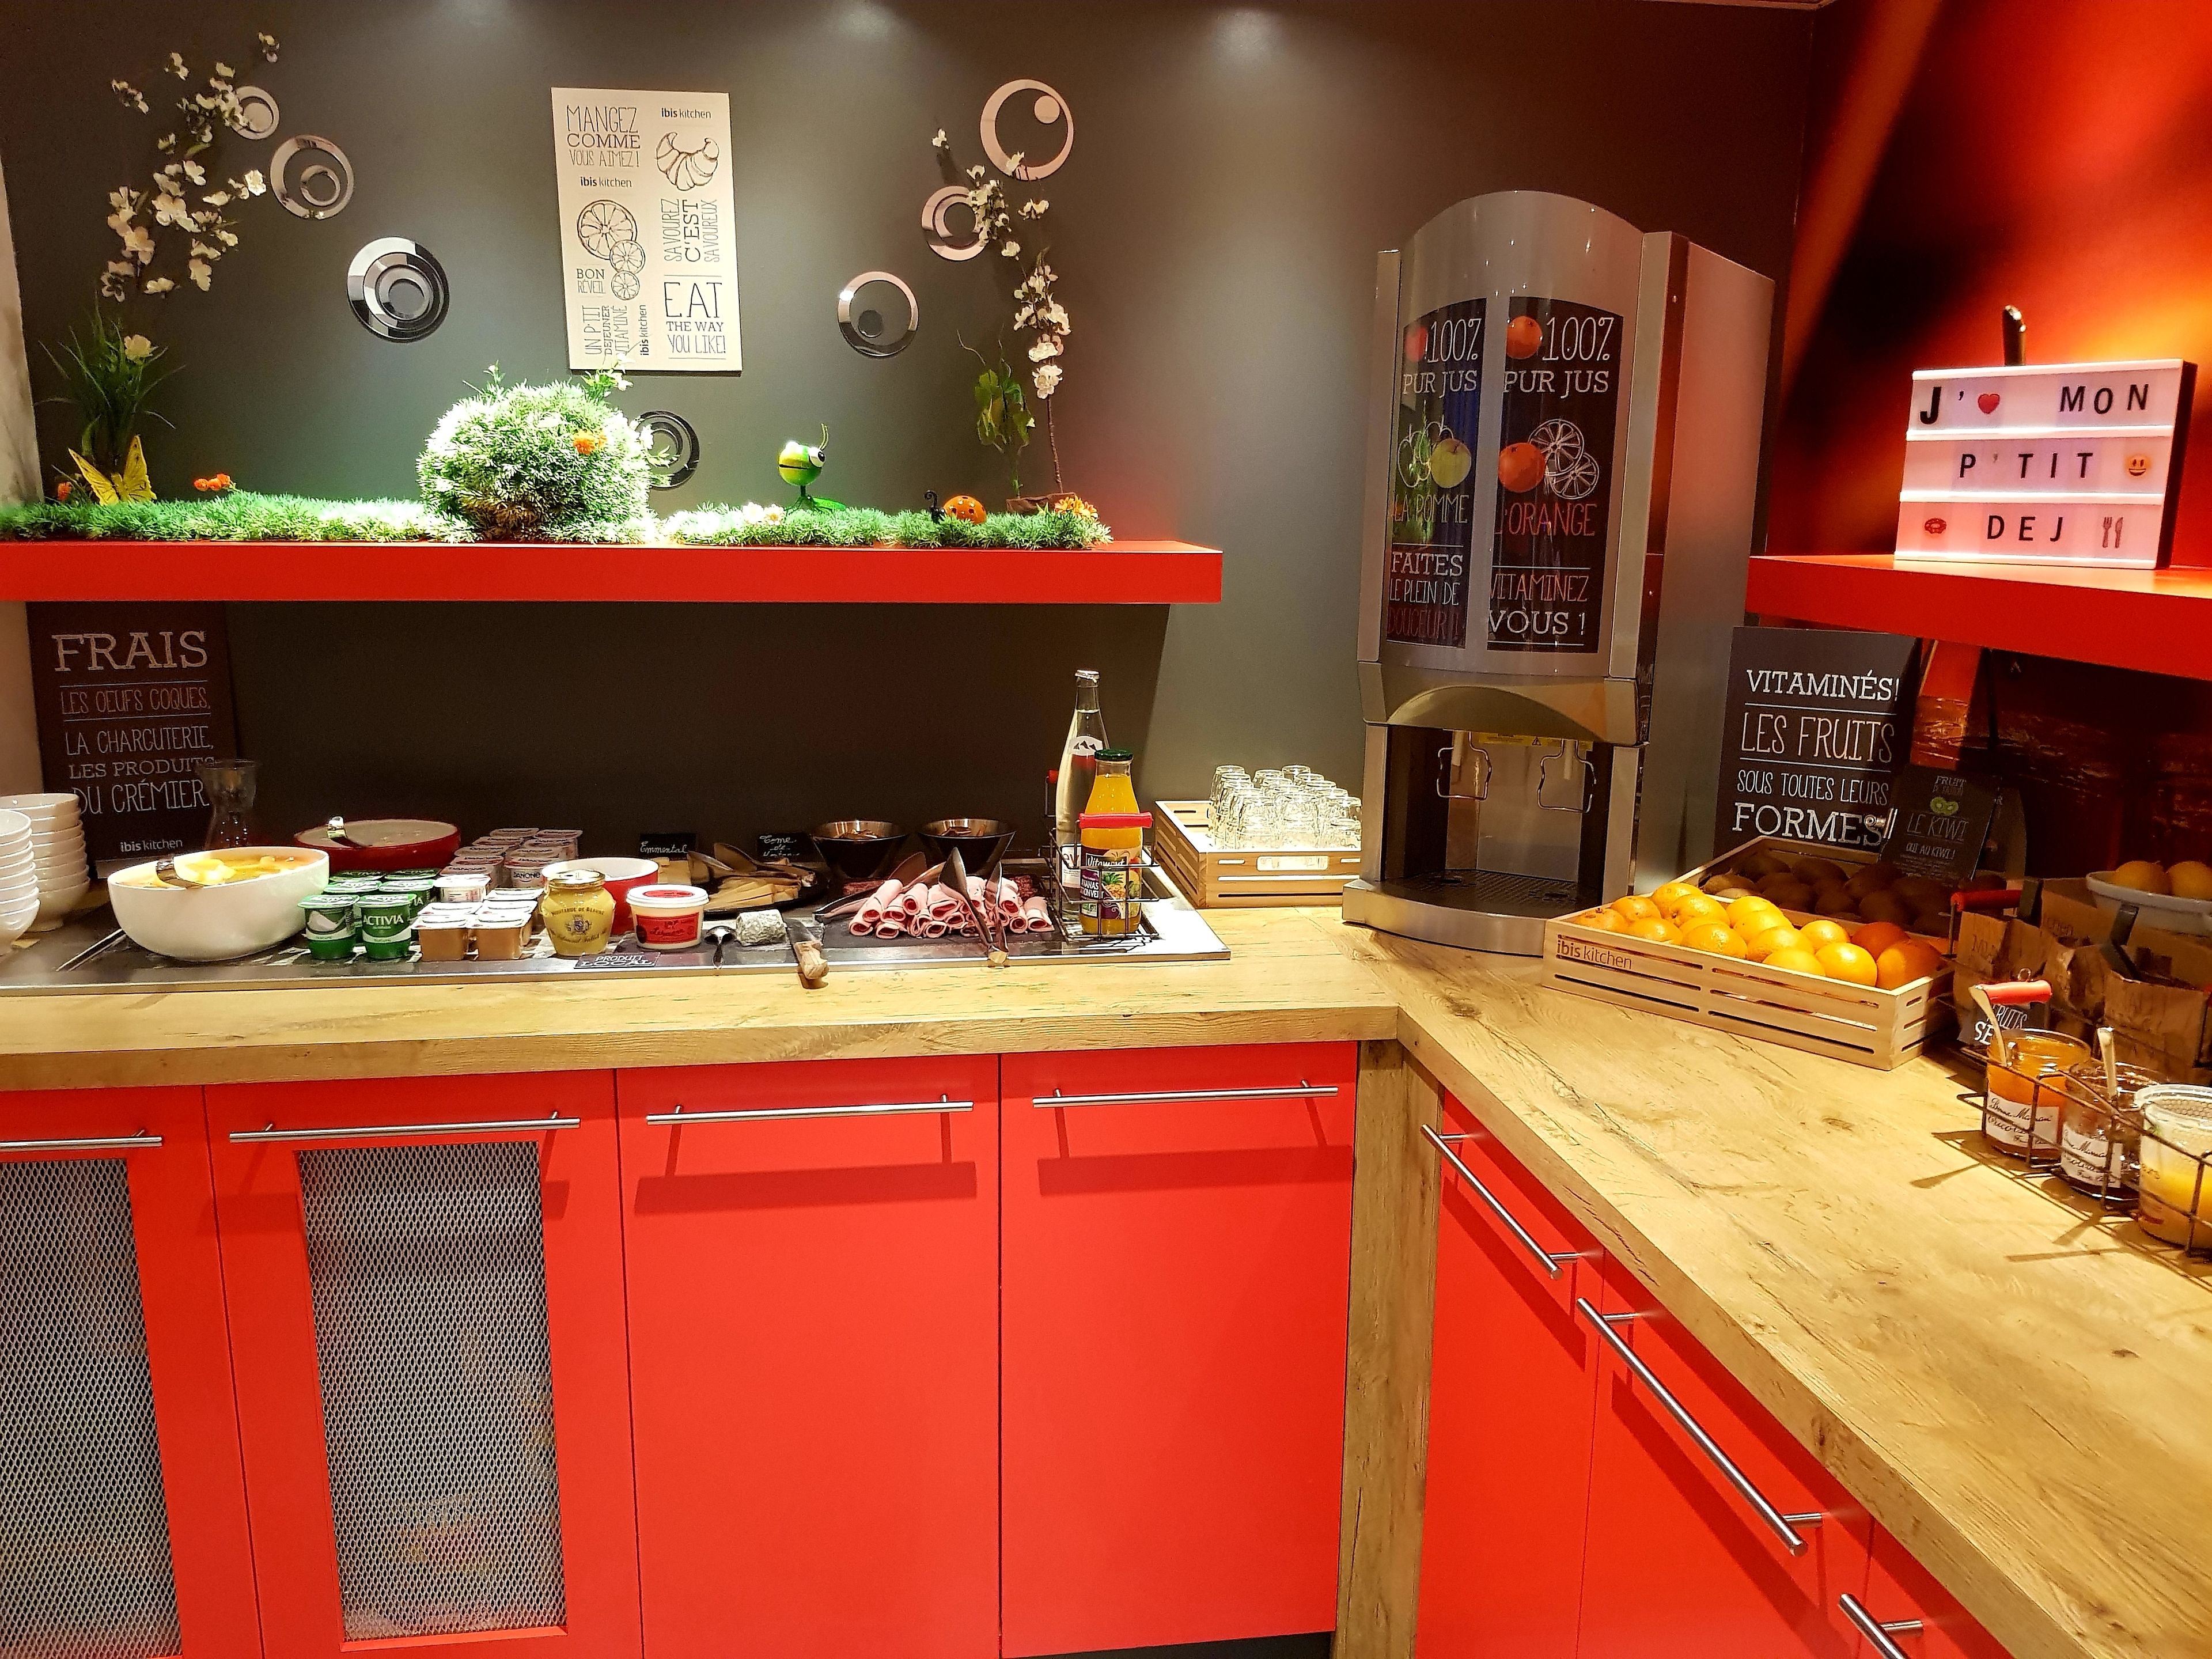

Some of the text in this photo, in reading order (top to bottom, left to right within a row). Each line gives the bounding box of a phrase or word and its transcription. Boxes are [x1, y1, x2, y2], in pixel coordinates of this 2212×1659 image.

[567, 105, 638, 133] MANGEZ
[662, 108, 711, 119] ibis kitchen
[567, 133, 640, 149] COMME
[569, 149, 594, 166] VOUS
[581, 176, 632, 187] ibis kitchen
[661, 199, 682, 262] SAVOUREZ
[682, 199, 701, 262] C'EST
[701, 199, 719, 262] SAVOUREUX
[576, 268, 605, 279] BON
[577, 278, 606, 294] RÉVEIL
[664, 282, 722, 318] EAT
[638, 305, 649, 355] ibis kitchen
[666, 321, 724, 332] THE WAY
[1427, 318, 1482, 363] 100%
[1542, 316, 1615, 362] 100%
[584, 339, 602, 354] UN
[668, 335, 726, 354] YOU LIKE!
[1402, 370, 1479, 399] PUR JUS
[1503, 370, 1610, 399] PUR JUS
[2059, 383, 2149, 414] MON
[1394, 493, 1469, 524] LA POMME
[1987, 515, 2063, 542] DEJ
[1391, 551, 1463, 577] FAITES
[1389, 578, 1461, 606] LE PLEIN DE
[1490, 573, 1589, 602] VITAMINEZ
[1488, 610, 1569, 635] VOUS
[51, 630, 209, 672] FRAIS
[1746, 669, 1899, 702] VITAMINÉS!
[60, 690, 89, 715] LES
[96, 690, 143, 714] OEUFS
[65, 725, 214, 756] LA CHARCUTERIE,
[1741, 712, 1895, 764] LES FRUITS
[68, 763, 107, 779] LES
[71, 778, 210, 815] DU CRÉMIER
[1737, 770, 1889, 806] SOUS TOUTES LEURS
[1732, 802, 1884, 847] FORMES
[1907, 813, 1969, 841] LE KIWI
[120, 839, 183, 853] ibis kitchen
[363, 914, 404, 926] ACTIVIA
[1557, 940, 1632, 969] ibis kitchen
[2015, 1107, 2052, 1122] Maan
